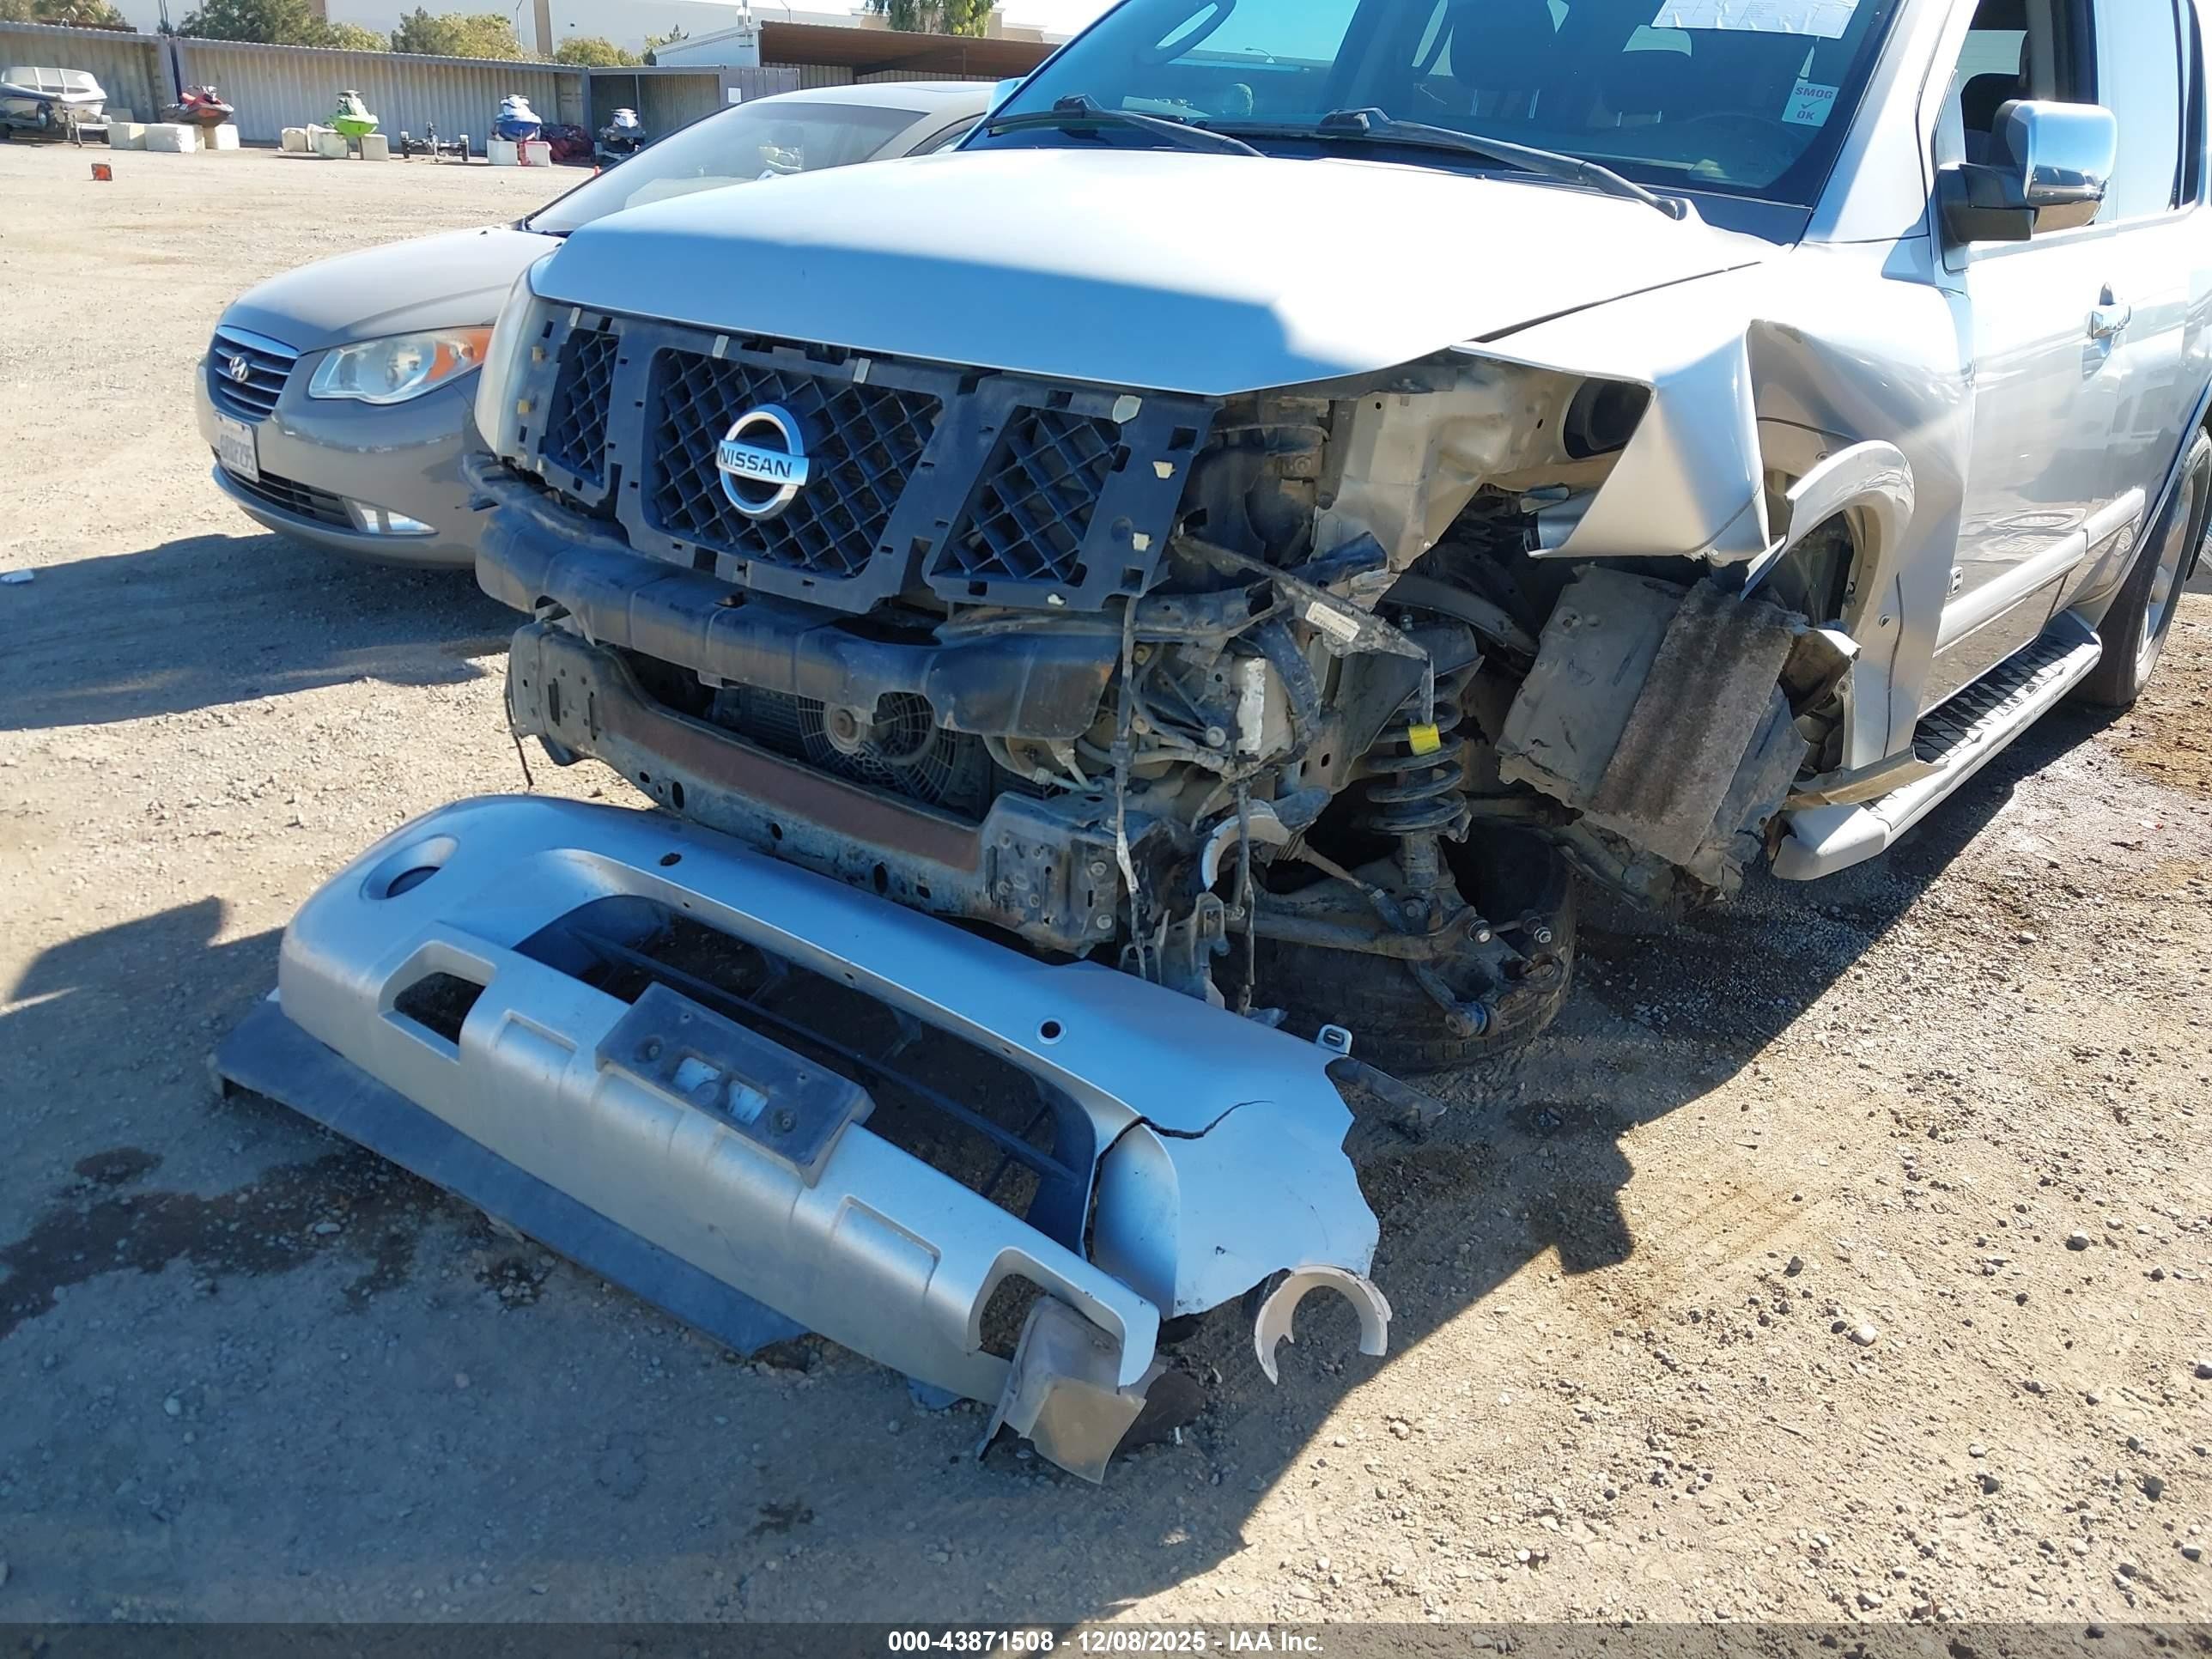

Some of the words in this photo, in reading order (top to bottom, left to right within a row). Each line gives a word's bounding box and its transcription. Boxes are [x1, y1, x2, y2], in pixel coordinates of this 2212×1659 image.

[1795, 87, 1833, 100] SMOG
[1796, 110, 1815, 120] OK
[719, 446, 793, 478] NISSAN
